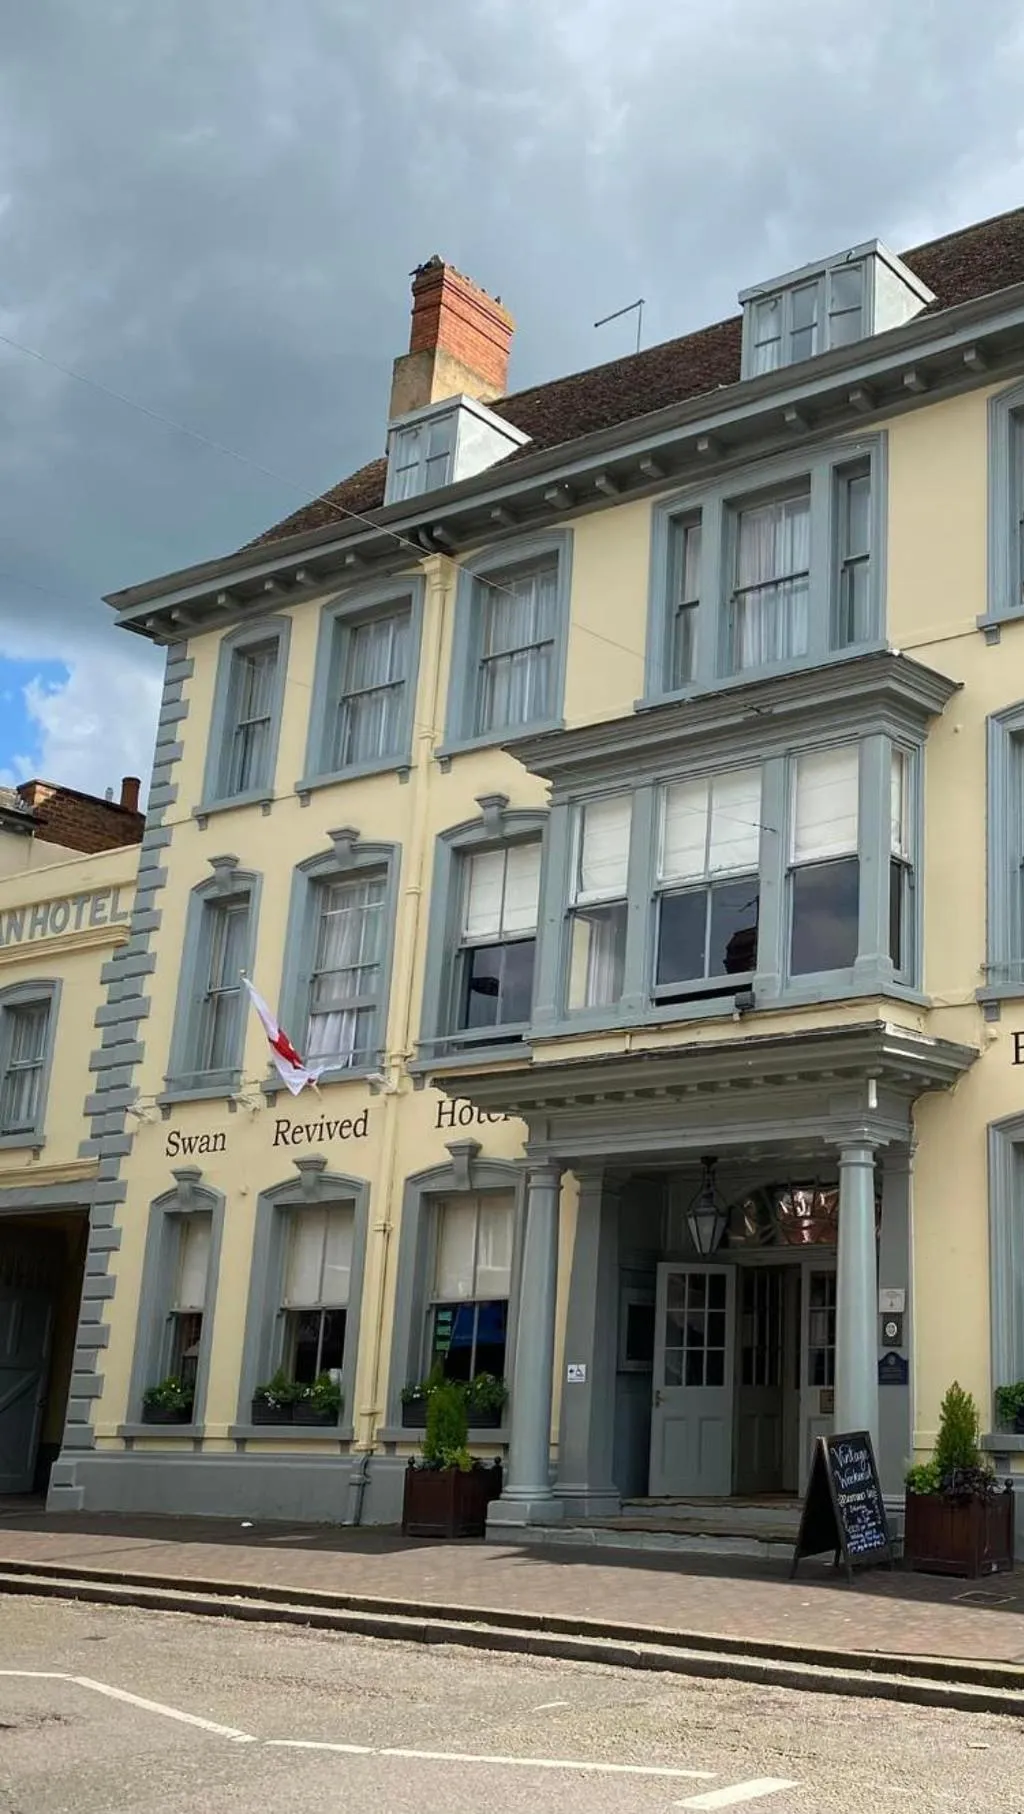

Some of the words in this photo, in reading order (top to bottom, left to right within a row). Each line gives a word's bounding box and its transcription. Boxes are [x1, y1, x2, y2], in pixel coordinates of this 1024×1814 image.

[28, 886, 129, 940] HOTEL
[165, 1131, 226, 1157] Swan
[272, 1109, 369, 1146] Revived
